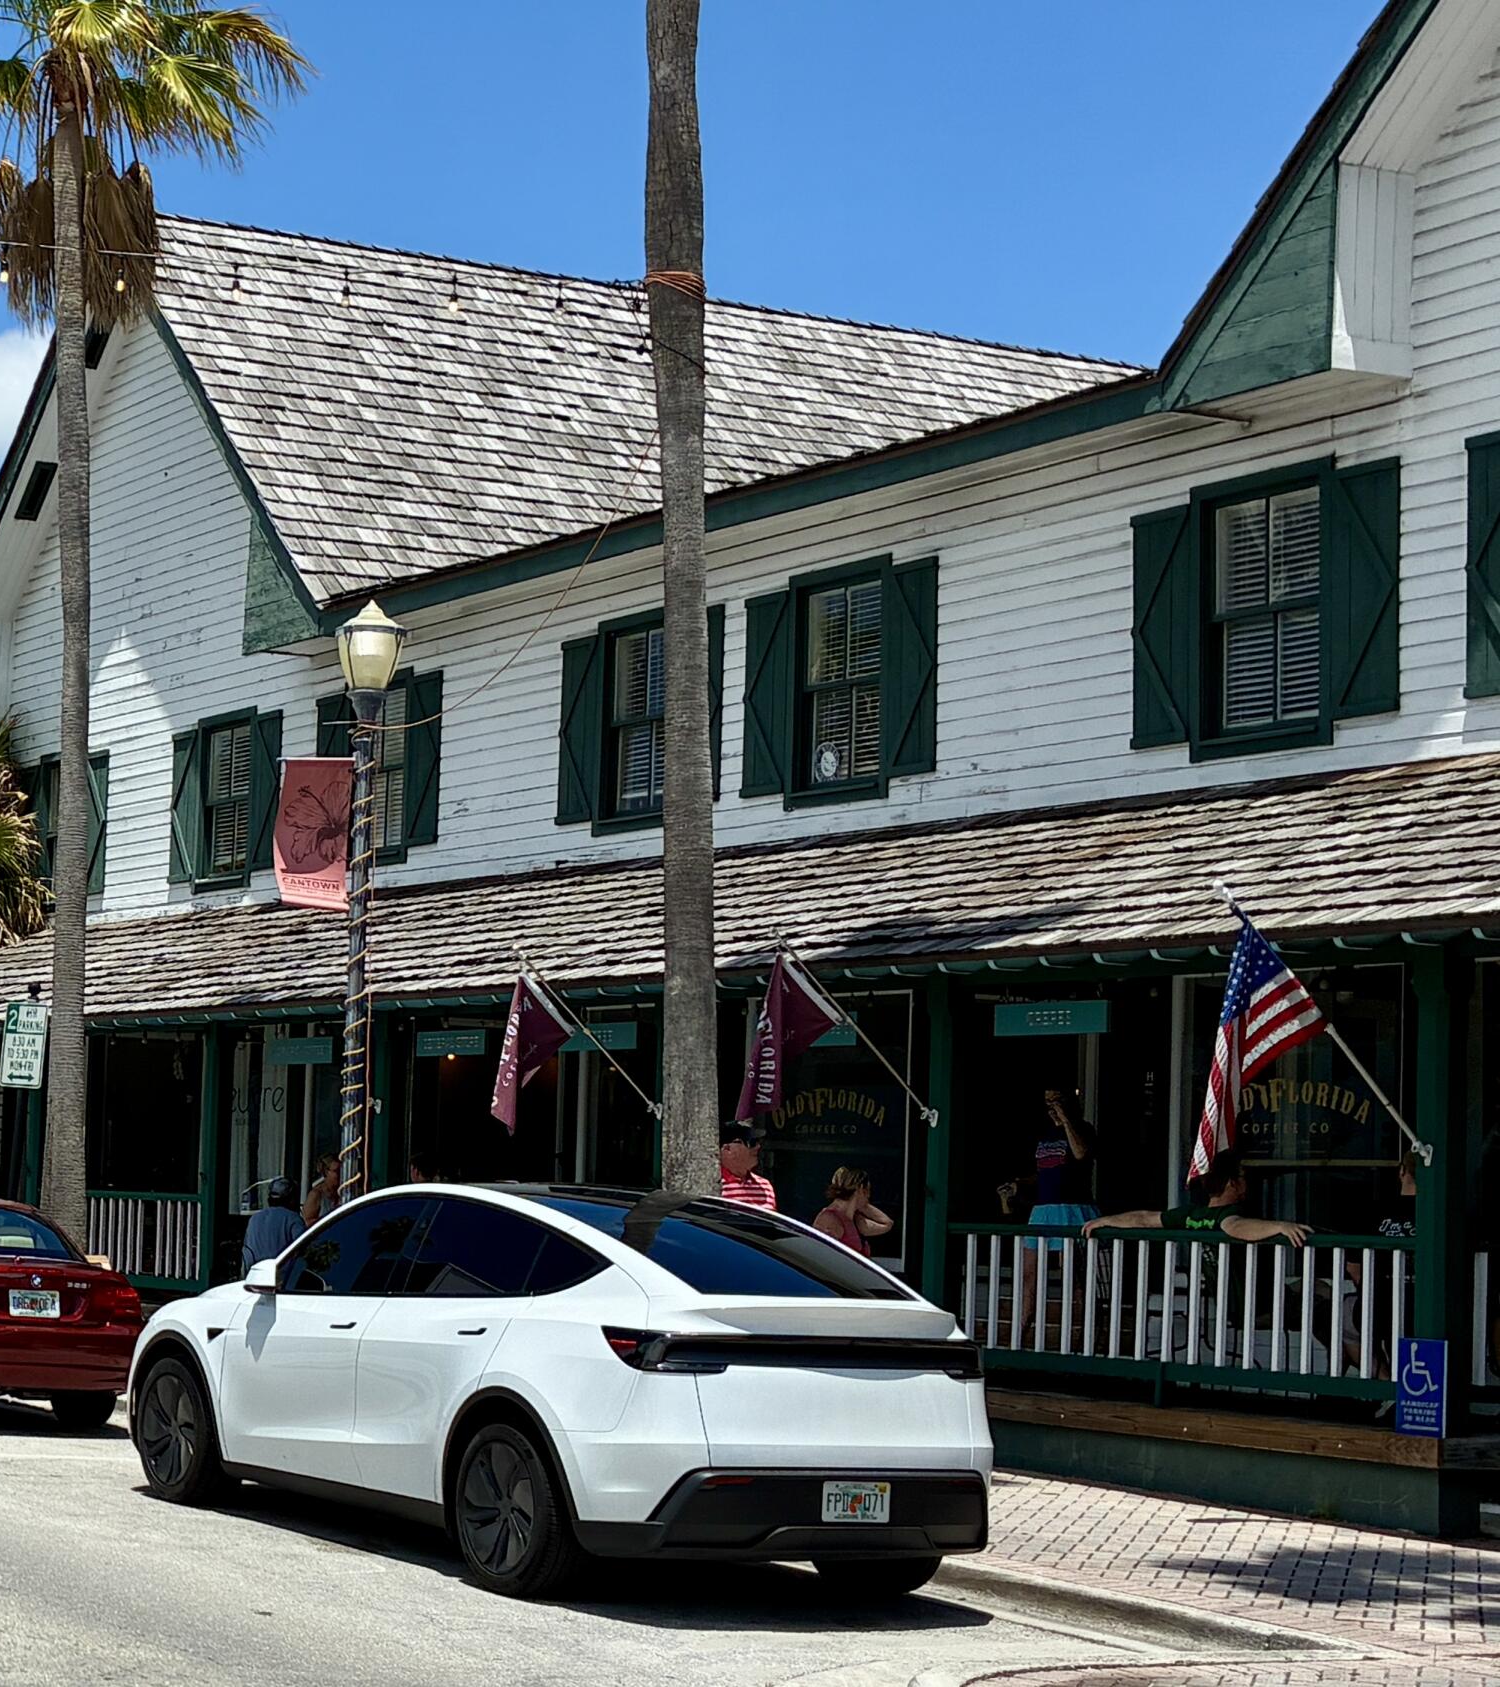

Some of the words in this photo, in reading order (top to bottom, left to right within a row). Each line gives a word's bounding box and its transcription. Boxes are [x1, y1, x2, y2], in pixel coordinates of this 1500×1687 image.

[282, 877, 340, 891] CANTOWN
[7, 1008, 18, 1030] 2
[19, 1020, 43, 1031] PARKING
[26, 1037, 36, 1047] AM
[7, 1047, 14, 1058] TO
[30, 1049, 39, 1060] PM
[1267, 1077, 1371, 1125] FLORIDA
[771, 1093, 805, 1129] OLD
[814, 1087, 886, 1128] FLORIDA
[794, 1124, 837, 1135] COFFEE
[842, 1124, 858, 1135] CO
[1242, 1122, 1299, 1135] COFFEE
[1309, 1121, 1330, 1134] CO
[1400, 1400, 1440, 1408] HANDICAP
[1403, 1407, 1437, 1416] PARKING
